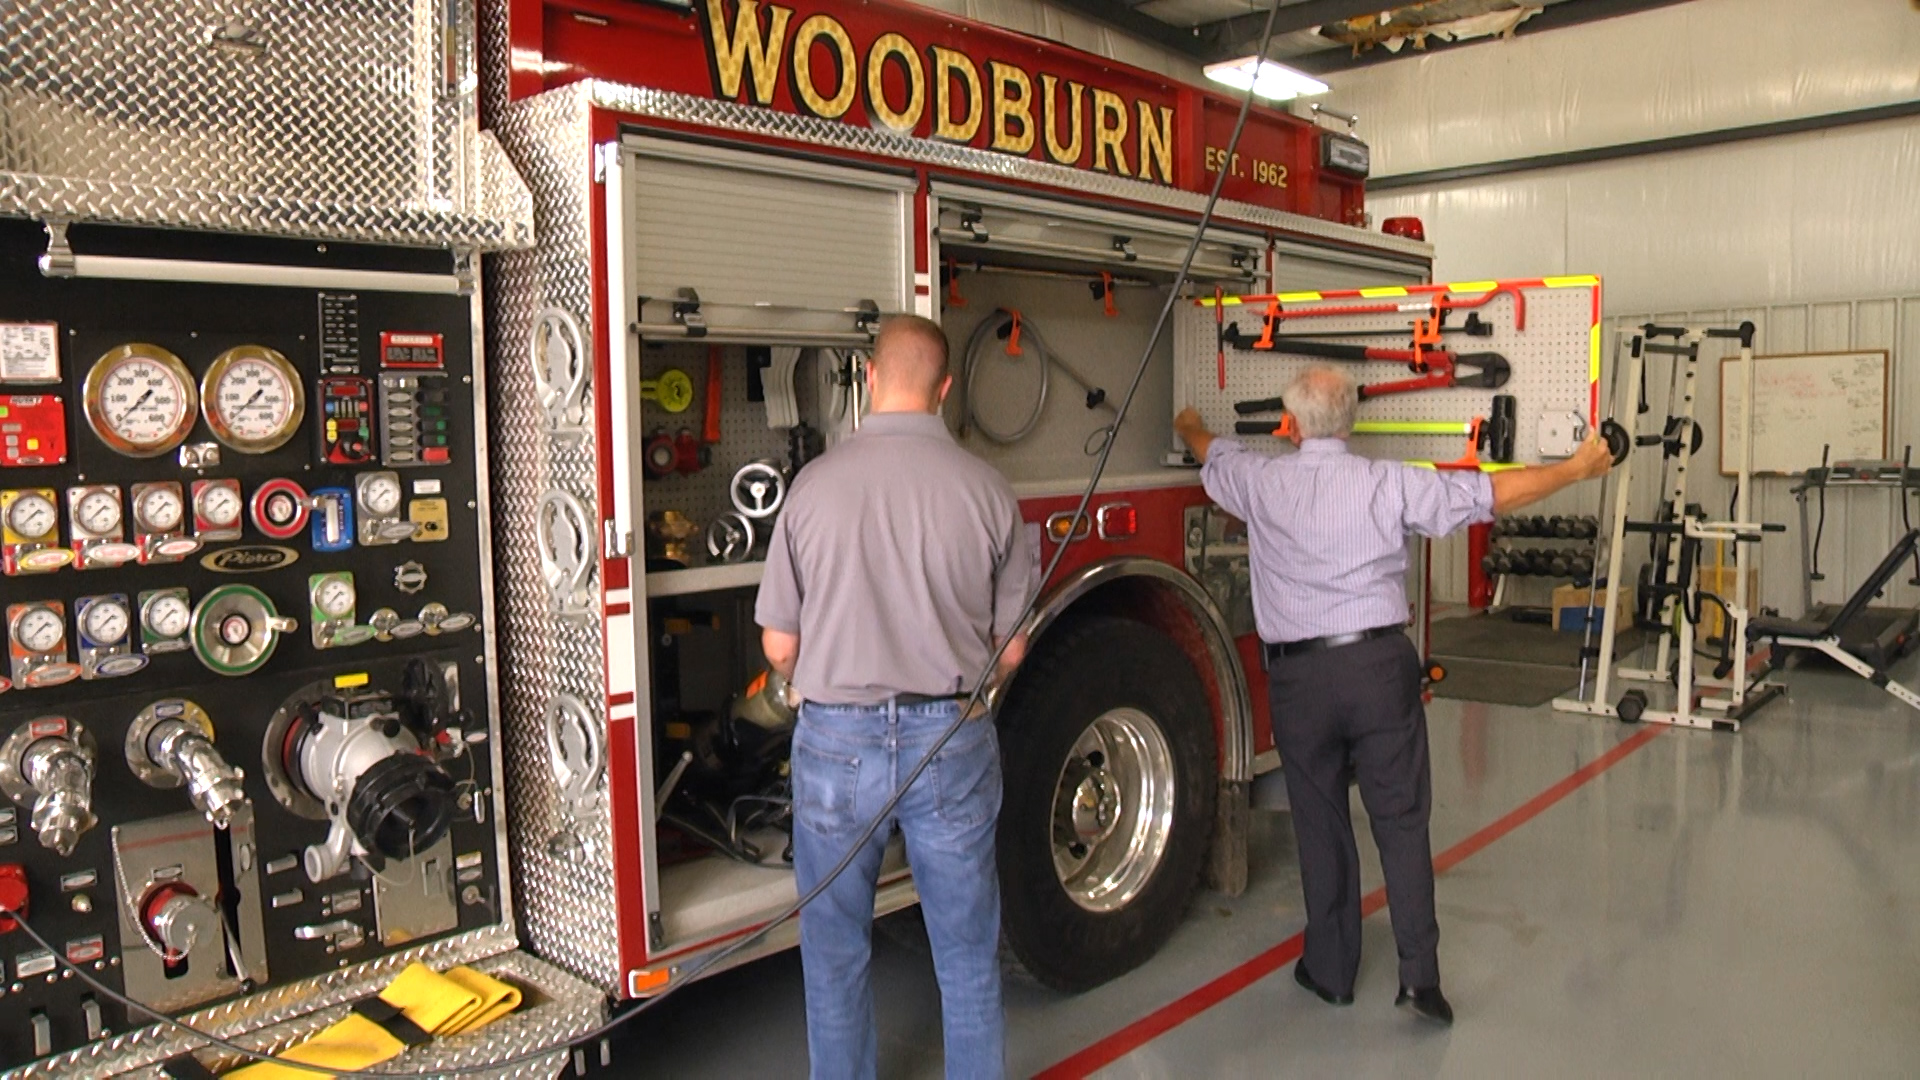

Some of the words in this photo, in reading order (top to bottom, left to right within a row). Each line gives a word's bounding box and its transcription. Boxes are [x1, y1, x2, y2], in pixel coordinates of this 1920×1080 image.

[703, 0, 1174, 184] WOODBURN
[1205, 145, 1245, 178] EST.
[1252, 159, 1288, 188] 1962
[117, 377, 134, 386] 200
[110, 394, 127, 404] 100
[218, 550, 282, 567] Pierce
